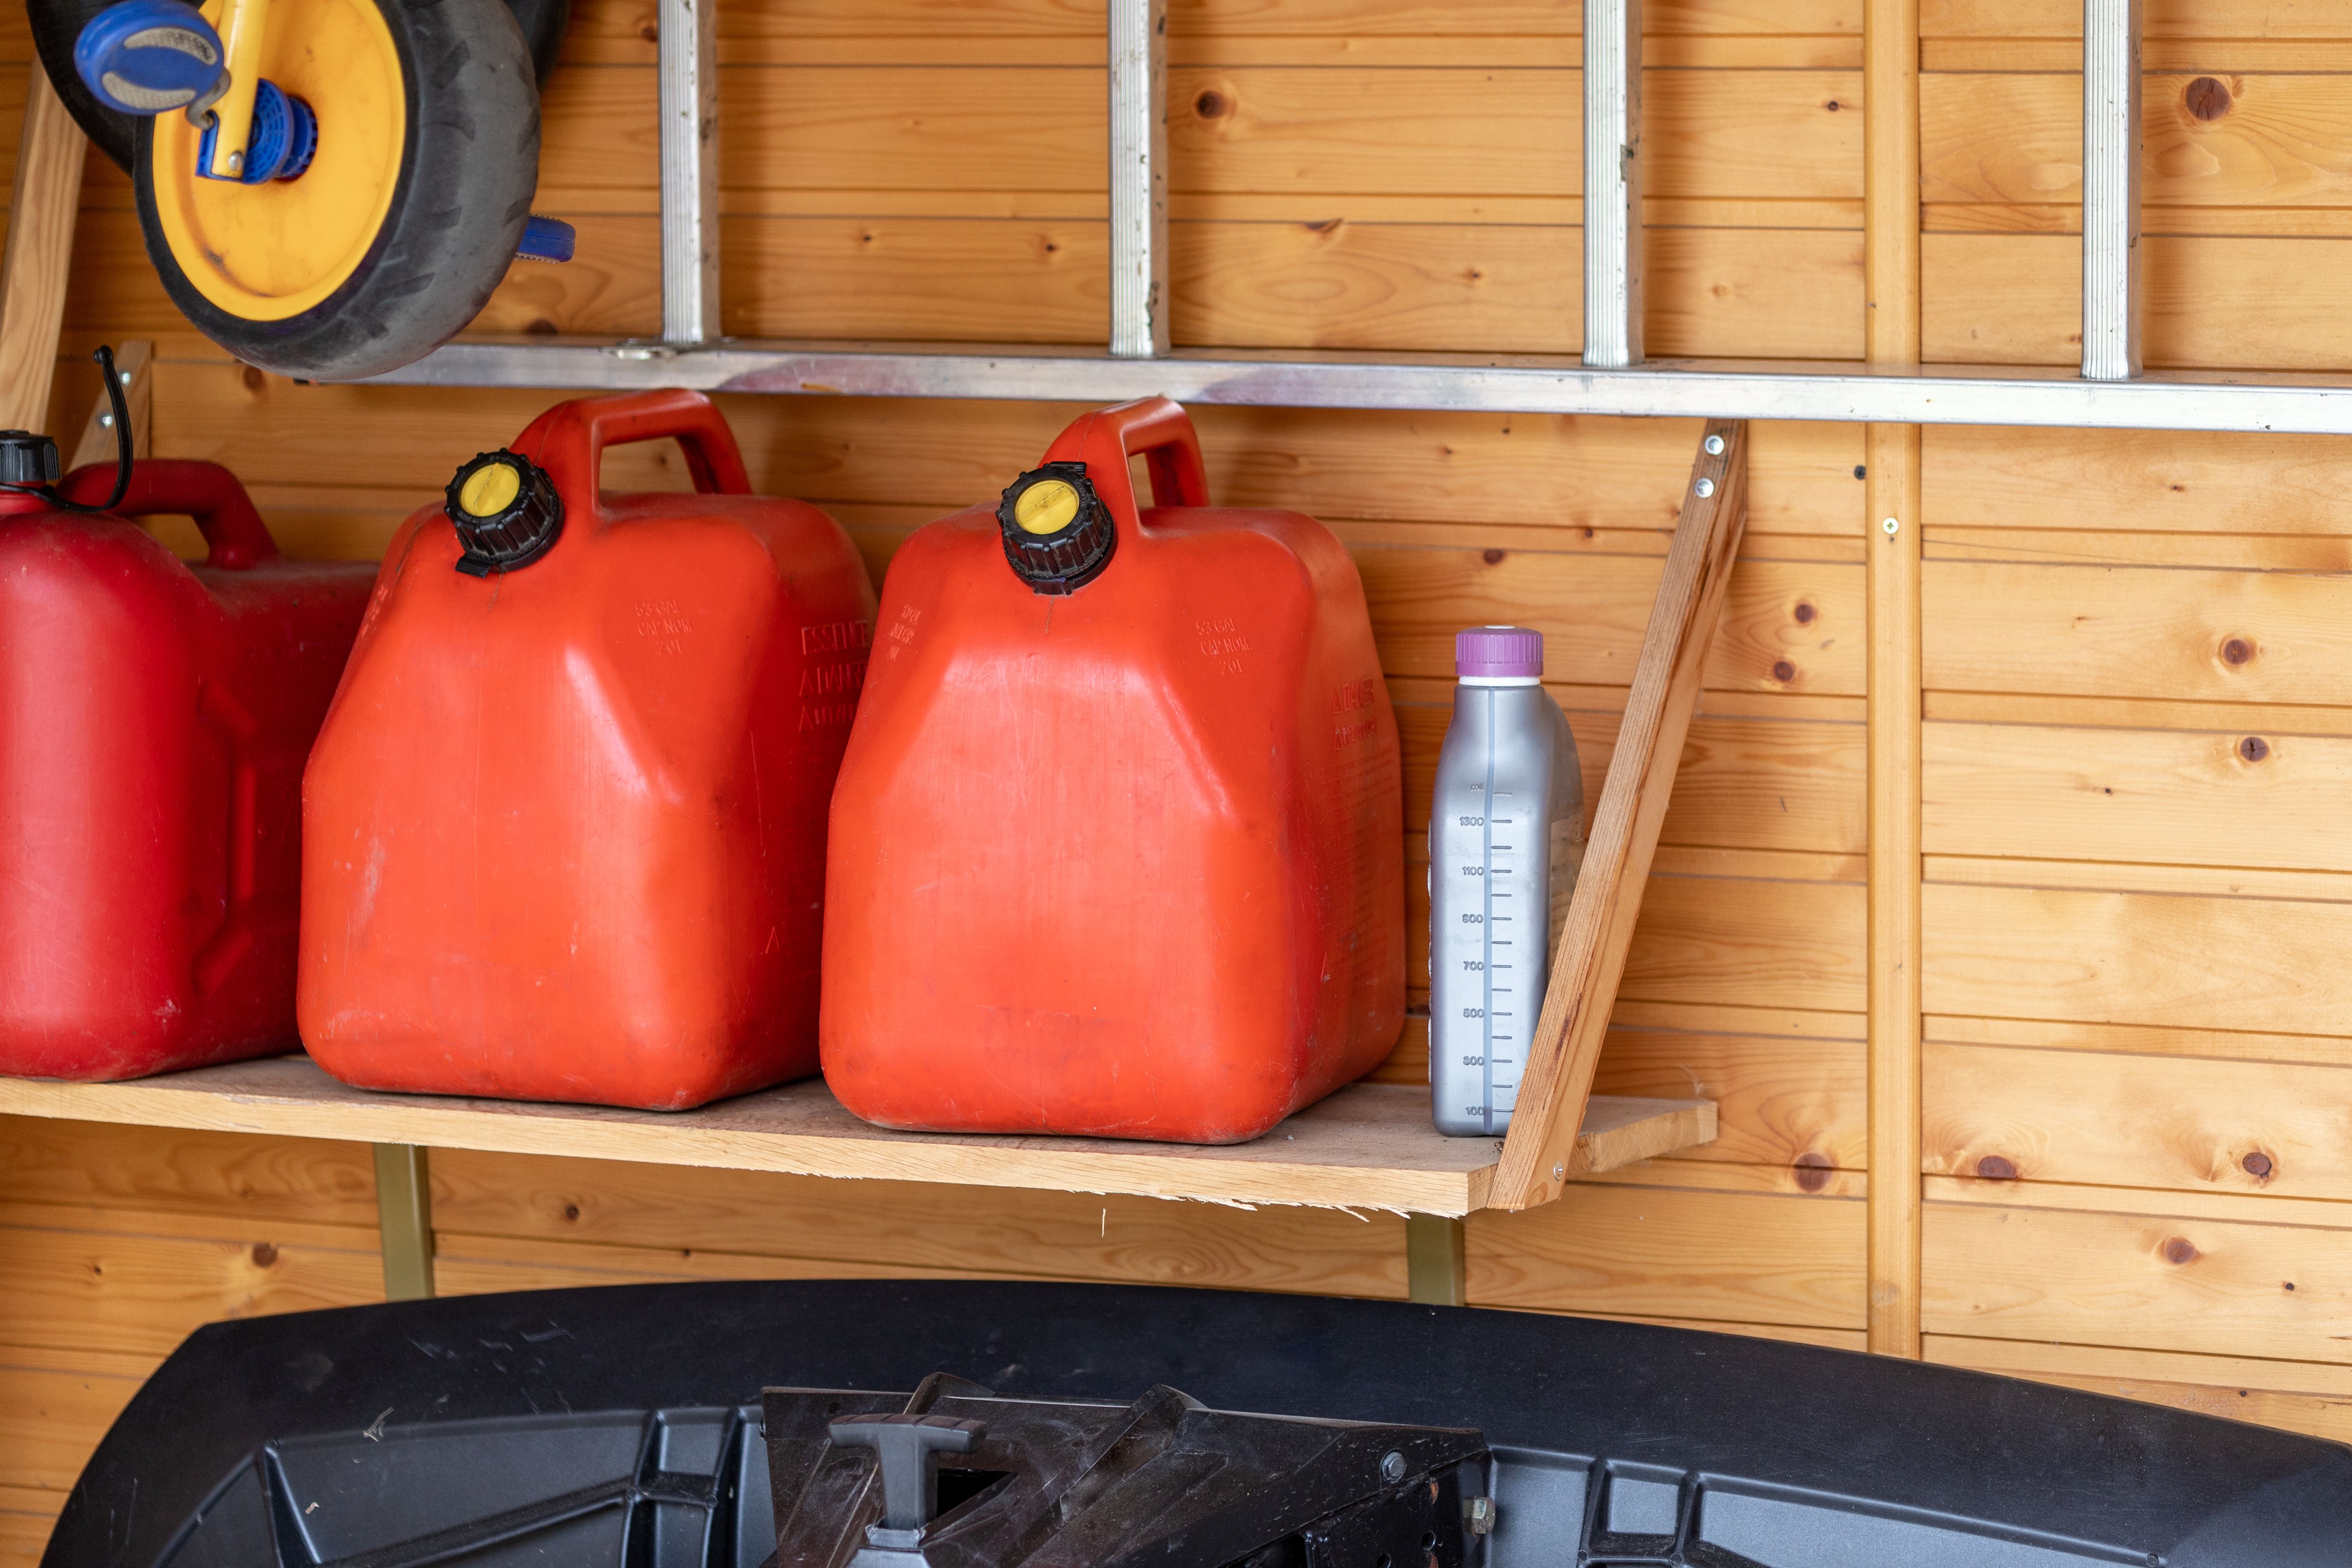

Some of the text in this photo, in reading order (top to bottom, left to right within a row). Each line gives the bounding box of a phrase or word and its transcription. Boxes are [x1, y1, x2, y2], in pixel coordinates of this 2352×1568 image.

[1459, 816, 1484, 826] 1300
[1462, 866, 1484, 876] 1100
[1462, 914, 1483, 923] 900
[1463, 961, 1484, 971] 700
[1463, 1008, 1484, 1018] 500
[1463, 1056, 1484, 1066] 300
[1465, 1106, 1484, 1116] 100
